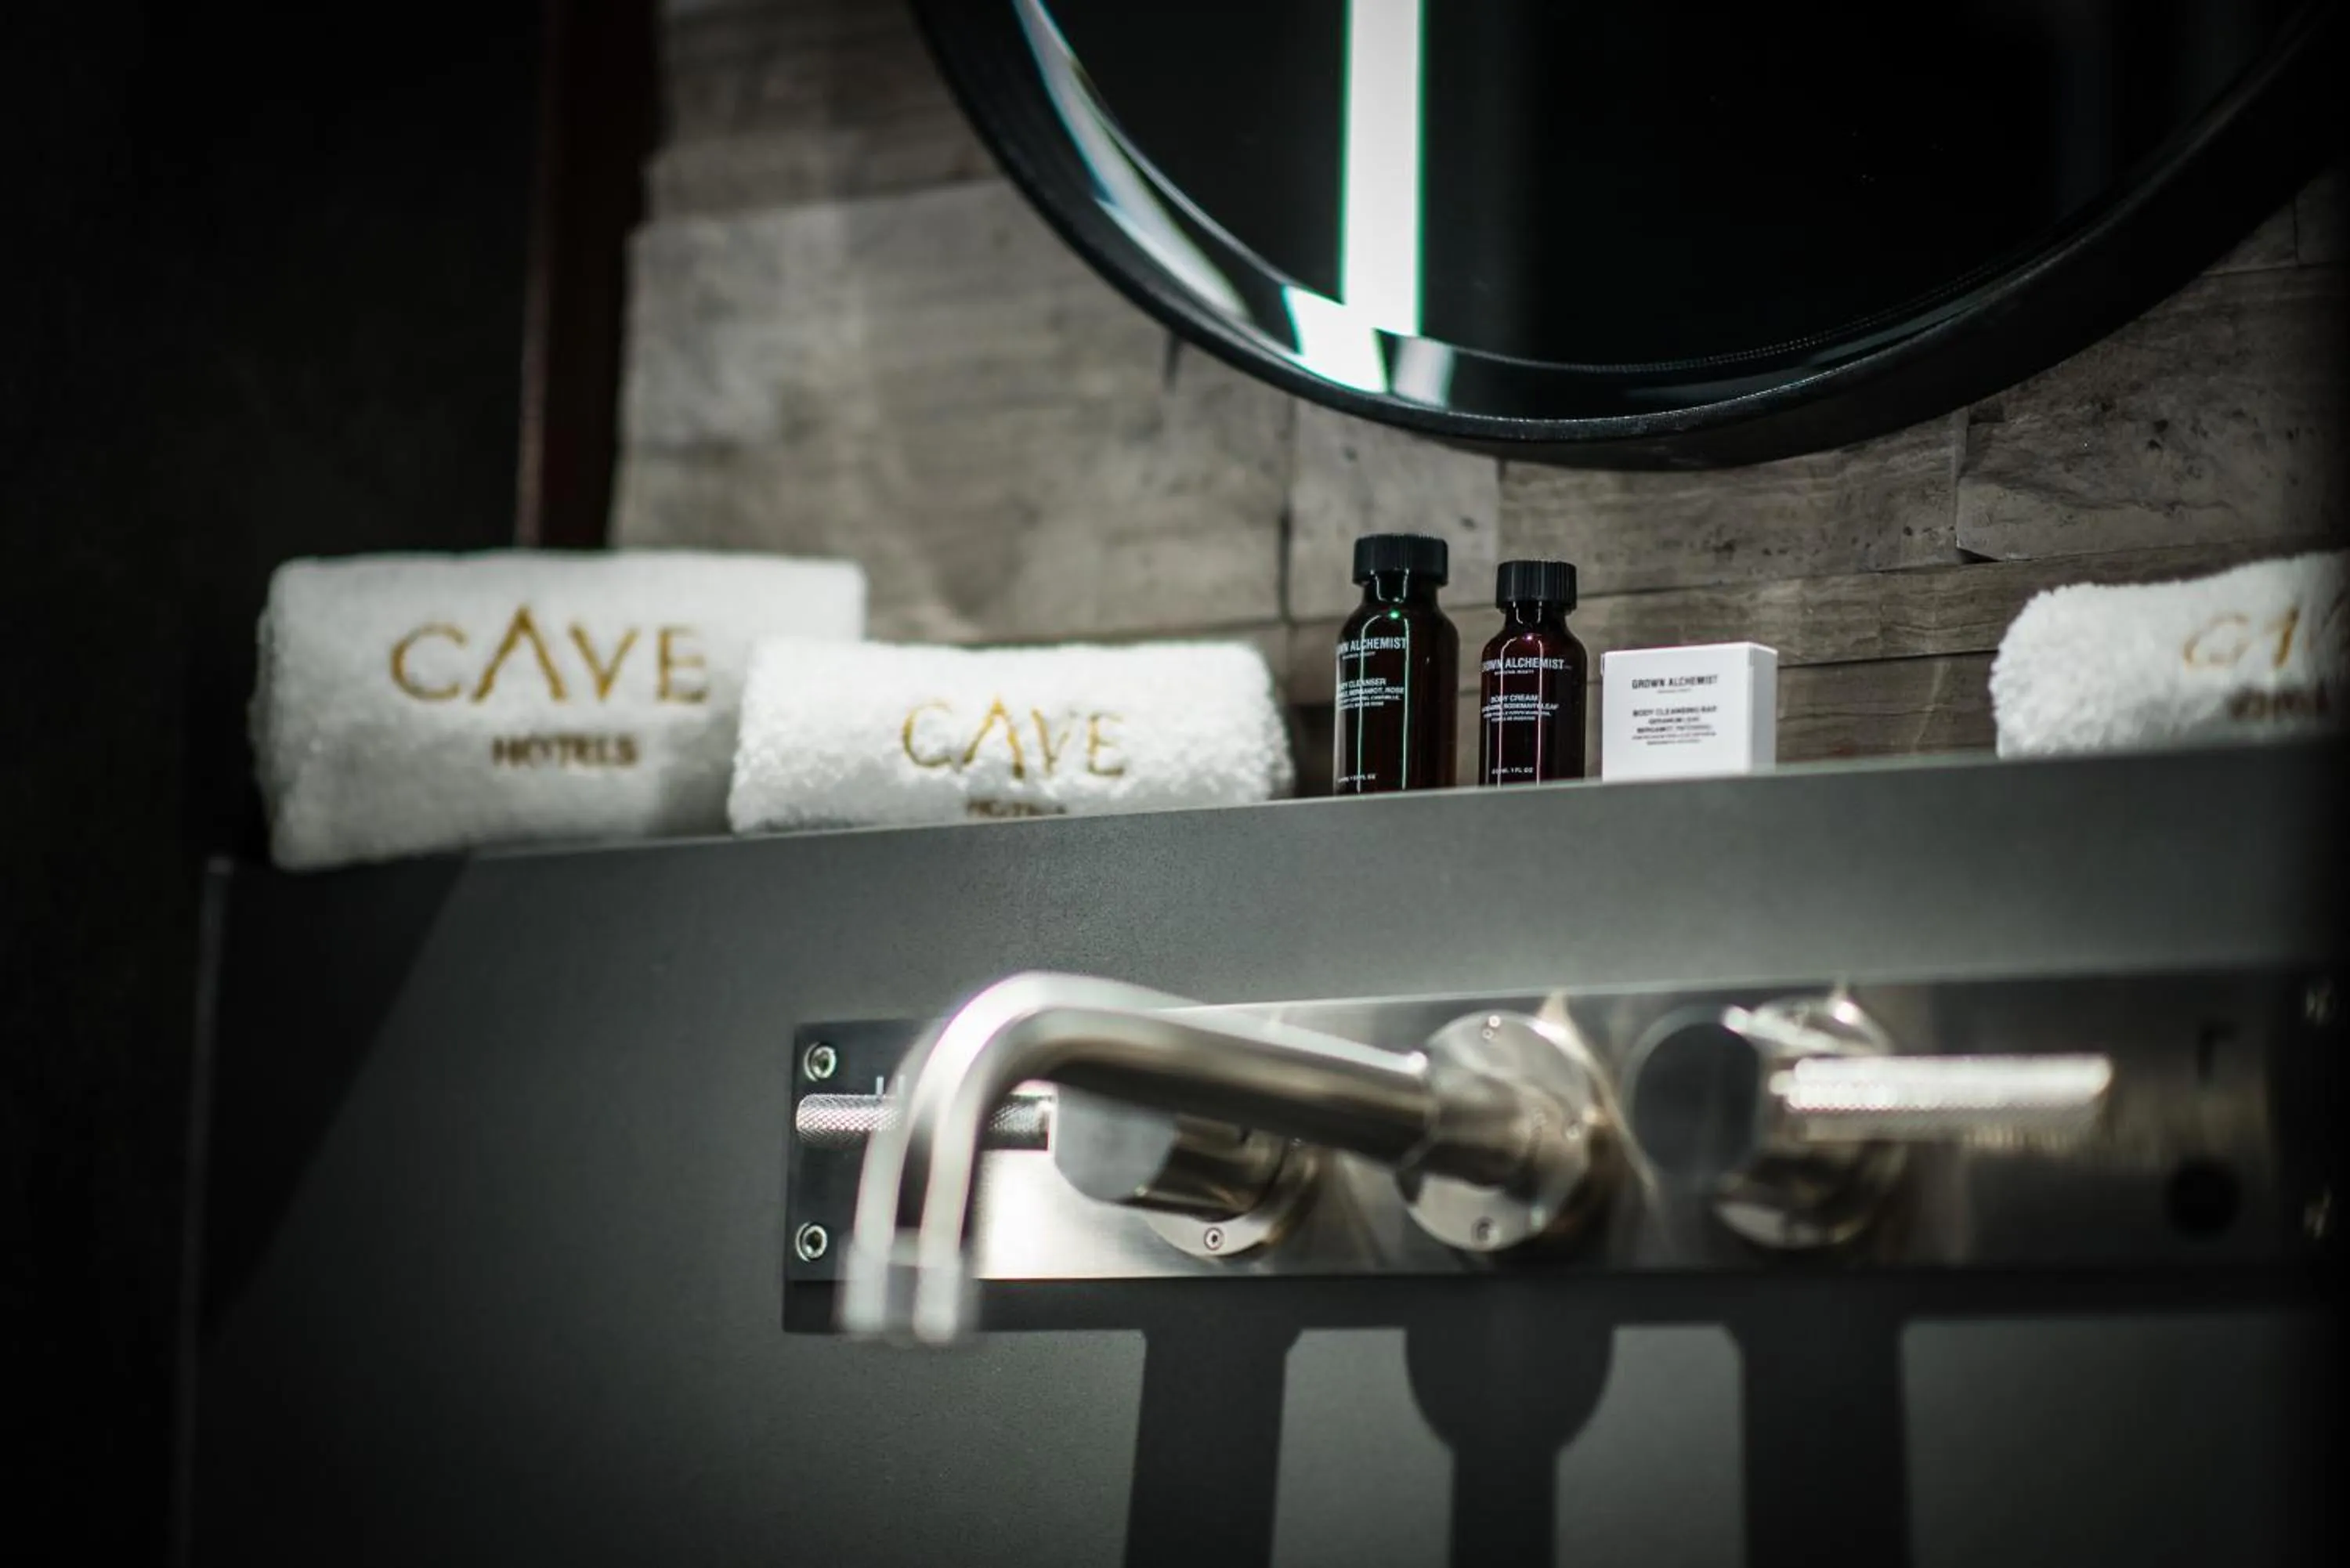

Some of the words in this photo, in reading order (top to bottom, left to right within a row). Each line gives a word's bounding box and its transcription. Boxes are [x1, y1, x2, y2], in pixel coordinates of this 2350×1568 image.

[1350, 637, 1407, 652] ALCHEMIST
[389, 604, 710, 703] CAVE
[1506, 657, 1564, 670] ALCHEMIST
[1632, 678, 1665, 689] GROWN
[1668, 674, 1719, 687] ALCHEMIST
[1491, 695, 1509, 703] BODY
[1509, 693, 1538, 703] CREAM
[902, 694, 1126, 781] CAVE
[491, 732, 639, 768] HOTELS
